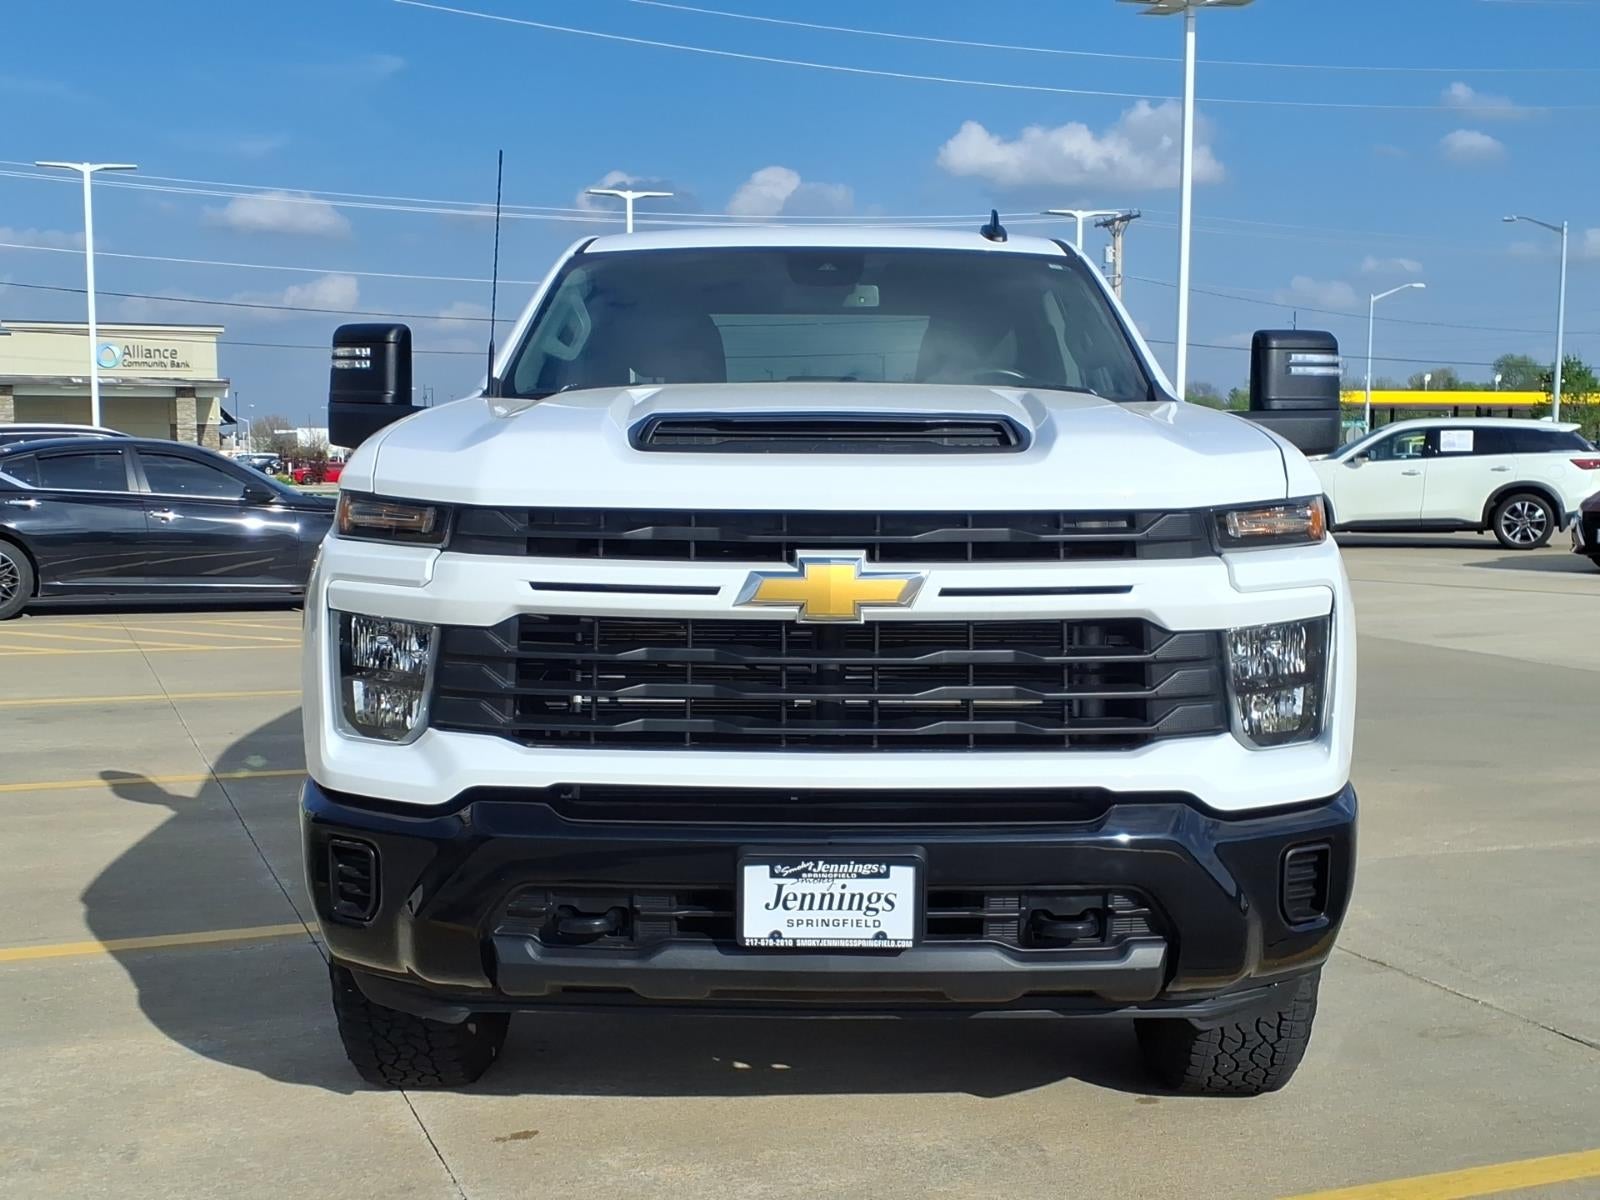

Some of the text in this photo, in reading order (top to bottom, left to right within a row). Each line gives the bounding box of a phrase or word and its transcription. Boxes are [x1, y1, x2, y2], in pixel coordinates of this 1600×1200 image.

[122, 344, 178, 359] Alliance
[121, 360, 190, 369] Community Bank
[812, 860, 880, 874] Jennings
[764, 883, 898, 917] Jennings
[786, 918, 882, 928] SPRINGFIELD
